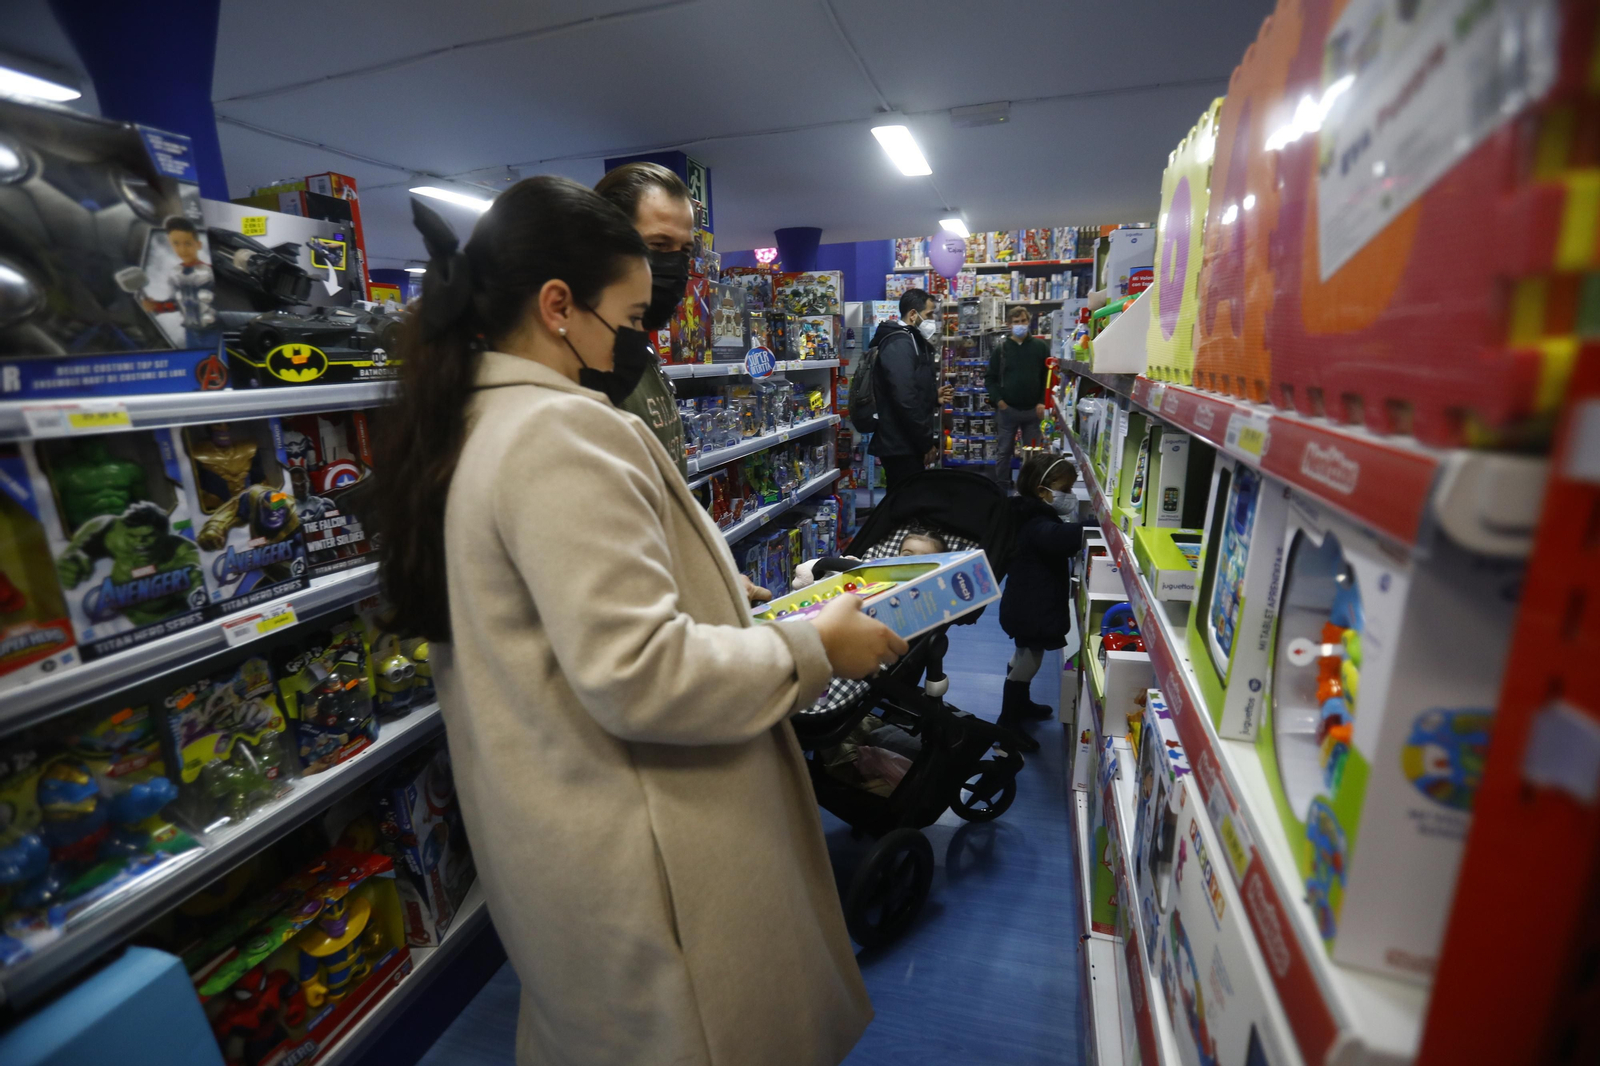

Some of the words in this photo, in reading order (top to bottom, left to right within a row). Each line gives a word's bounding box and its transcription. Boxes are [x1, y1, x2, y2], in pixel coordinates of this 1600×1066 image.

[93, 362, 135, 374] COSTUME
[136, 361, 153, 371] TOP
[154, 359, 169, 369] SET
[748, 351, 770, 366] SÚPER
[120, 371, 157, 382] COSTUME
[303, 521, 320, 534] THE
[319, 515, 347, 531] FALCON
[306, 537, 337, 553] WINTER
[336, 530, 366, 546] SOLDIER
[212, 539, 295, 588] AVENGERS
[83, 566, 192, 626] AVENGERS
[221, 598, 249, 613] TITAN
[248, 588, 272, 605] HERO
[272, 579, 303, 597] SERIES
[955, 573, 971, 600] vtech
[1161, 582, 1195, 590] juguettos
[95, 633, 134, 654] TITAN
[132, 624, 166, 642] HERO
[164, 611, 204, 633] SERIES
[1261, 608, 1274, 641] TABLET
[1240, 697, 1256, 736] juguettos
[1190, 818, 1225, 920] POCOYO
